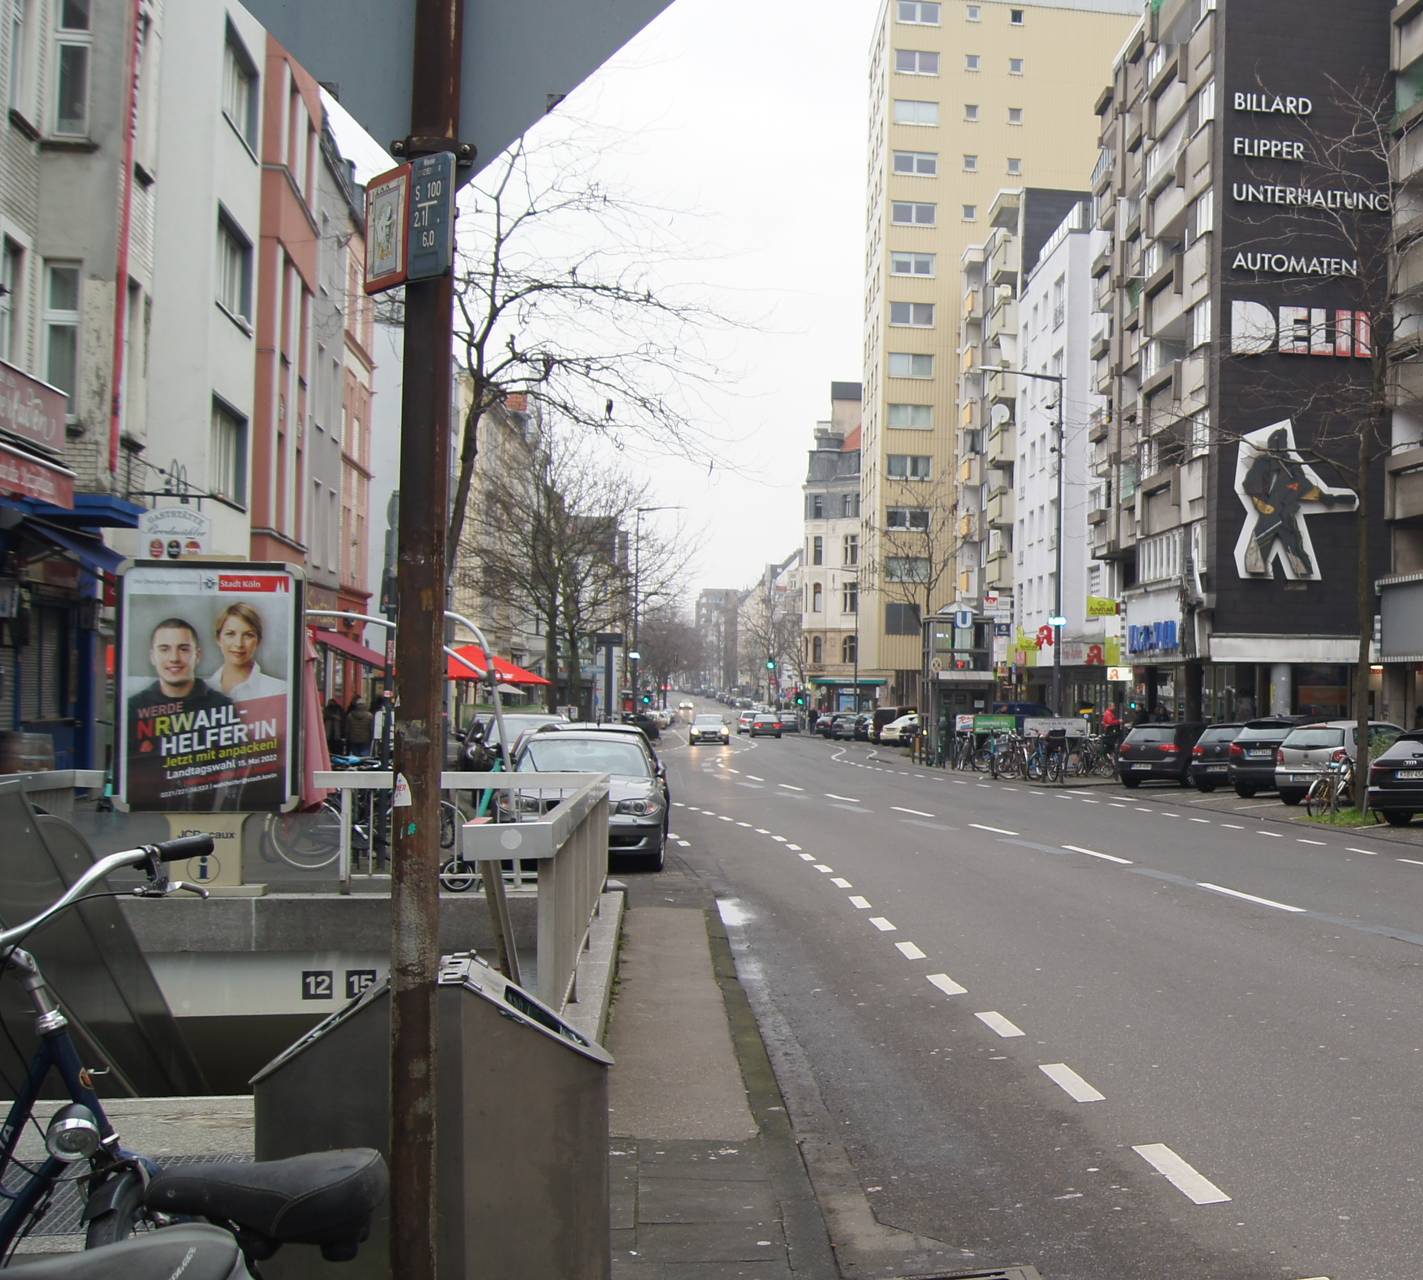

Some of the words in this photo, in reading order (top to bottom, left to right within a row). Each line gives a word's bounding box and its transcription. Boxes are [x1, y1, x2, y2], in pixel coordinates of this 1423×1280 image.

[1234, 92, 1312, 115] BILLARD
[1234, 137, 1304, 160] FLIPPER
[427, 180, 442, 197] 100
[1232, 251, 1358, 277] AUTOMATEN
[220, 580, 241, 589] Stadt
[242, 580, 261, 589] Köln
[957, 611, 972, 628] U
[137, 701, 184, 718] WERDE
[163, 754, 193, 768] Jetzt
[196, 751, 216, 761] mit
[218, 738, 277, 761] anpacken!
[166, 760, 236, 779] Landtagswahl
[178, 830, 235, 840] JCDcaux
[305, 976, 331, 994] 12
[350, 975, 373, 995] 15
